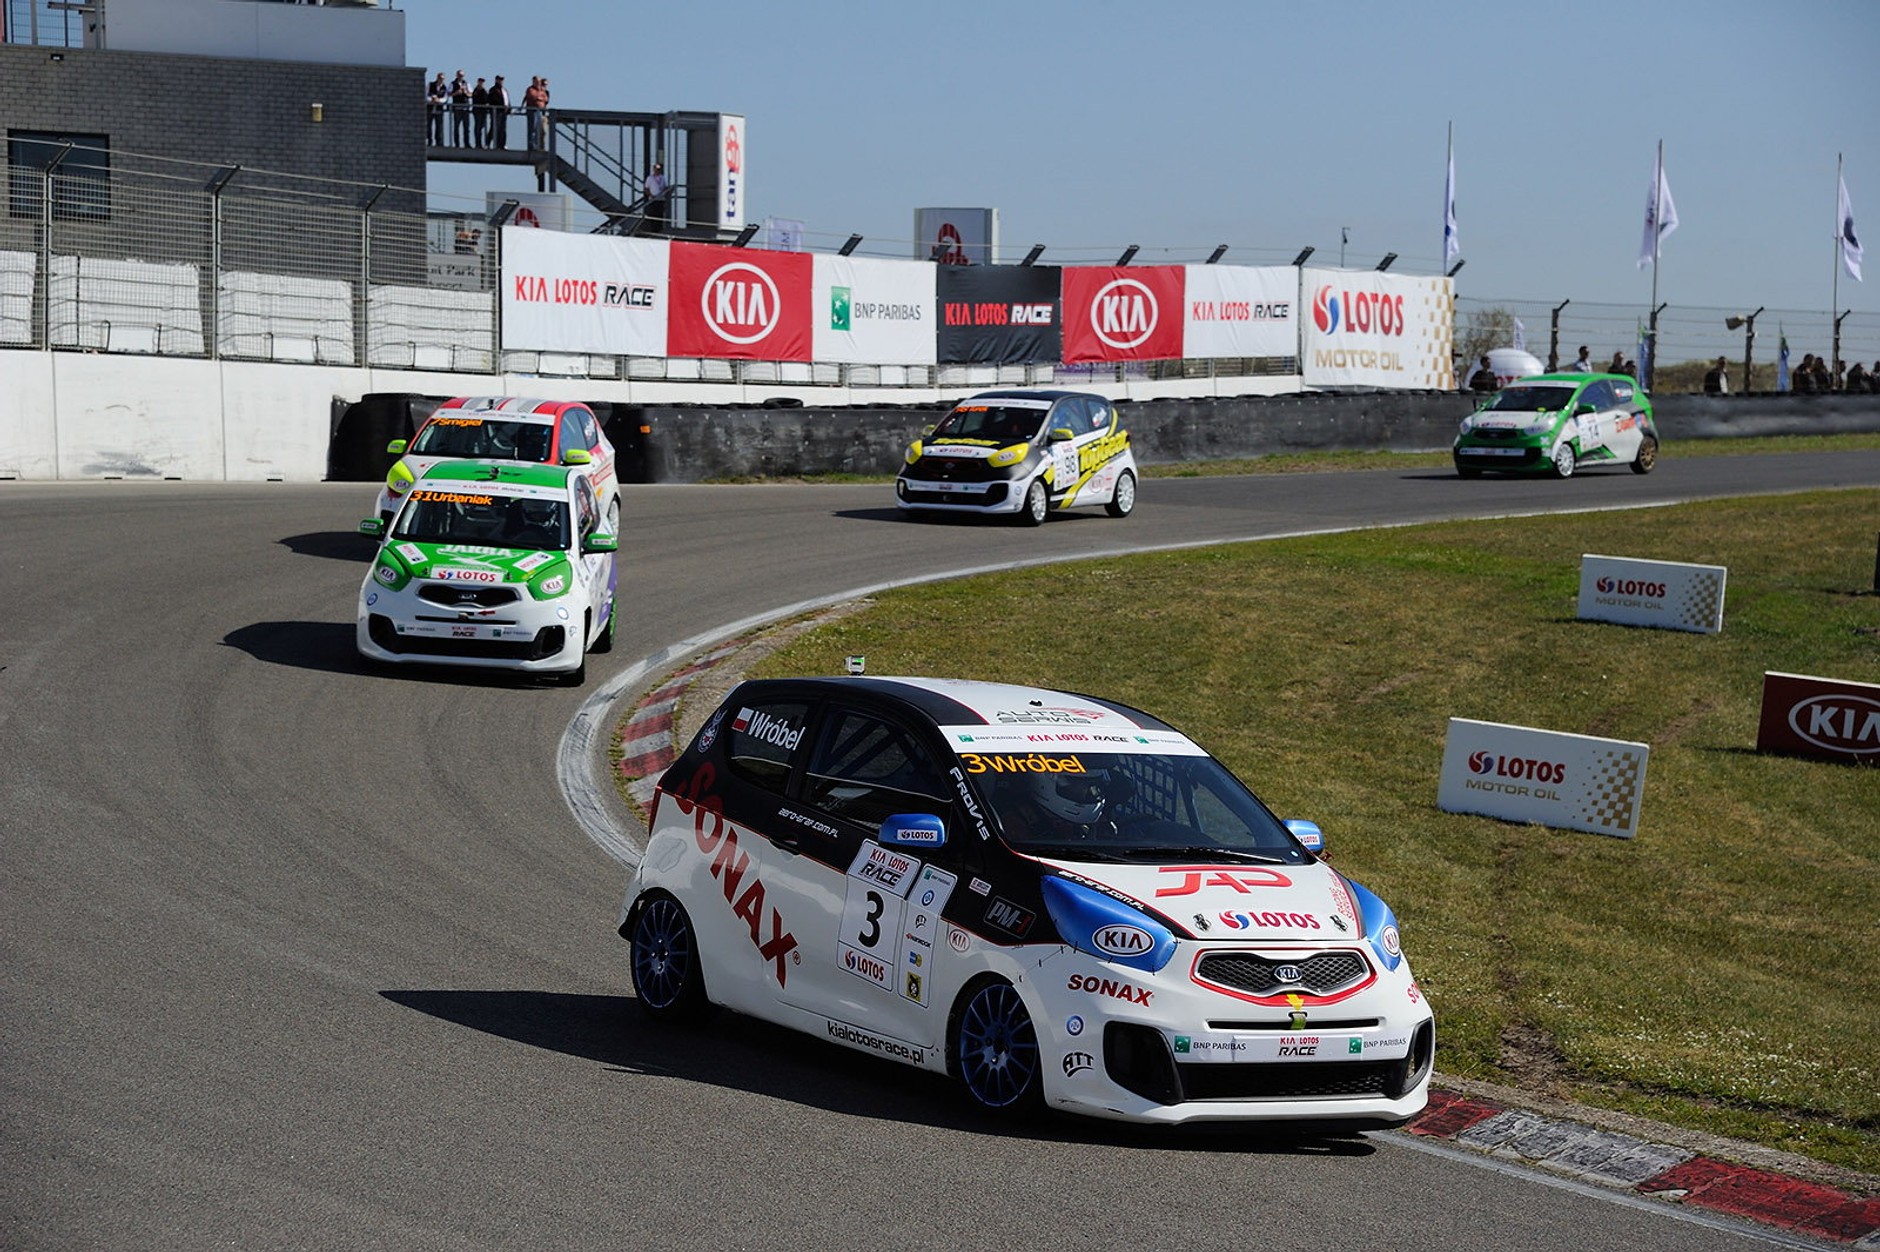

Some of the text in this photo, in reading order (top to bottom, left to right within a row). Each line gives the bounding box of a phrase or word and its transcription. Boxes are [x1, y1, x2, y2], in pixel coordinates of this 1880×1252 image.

[515, 276, 655, 307] KIA LOTOS RACE
[716, 279, 768, 327] KIA
[854, 303, 921, 321] BNP PARIBAS
[1193, 303, 1288, 321] KIA LOTOS RACE
[945, 303, 1053, 326] KIA LOTOS RACE
[1103, 295, 1149, 333] KIA
[1343, 291, 1404, 337] LOTOS
[1315, 349, 1404, 371] MOTOR OIL
[1065, 455, 1076, 474] 98
[381, 567, 395, 581] KIA
[456, 570, 496, 582] LOTOS
[545, 580, 563, 590] KIA
[1616, 580, 1666, 598] LOTOS
[1595, 597, 1665, 610] MOTOR OIL
[748, 711, 805, 751] Wróbel
[1810, 704, 1880, 743] KIA
[1026, 734, 1054, 742] KIA
[1056, 733, 1089, 741] LOTOS
[1092, 735, 1129, 743] RACE
[1496, 755, 1565, 784] LOTOS
[1466, 779, 1562, 800] MOTOR OIL
[910, 831, 934, 840] LOTOS
[870, 848, 910, 873] KIA LOTOS
[860, 863, 902, 887] RACE
[857, 890, 885, 948] 3
[1249, 911, 1320, 930] LOTOS
[951, 932, 968, 947] KIA
[1104, 929, 1144, 950] KIA
[1385, 933, 1399, 949] KIA
[856, 955, 885, 981] LOTOS
[1280, 968, 1299, 979] KIA
[1067, 973, 1153, 1008] SONAX
[827, 1020, 925, 1064] kialotosrace.pl
[1193, 1041, 1246, 1051] BNP PARIBAS
[1280, 1036, 1320, 1045] KIA LOTOS
[1363, 1037, 1407, 1049] BNP PARIBAS
[1278, 1046, 1316, 1056] RACE
